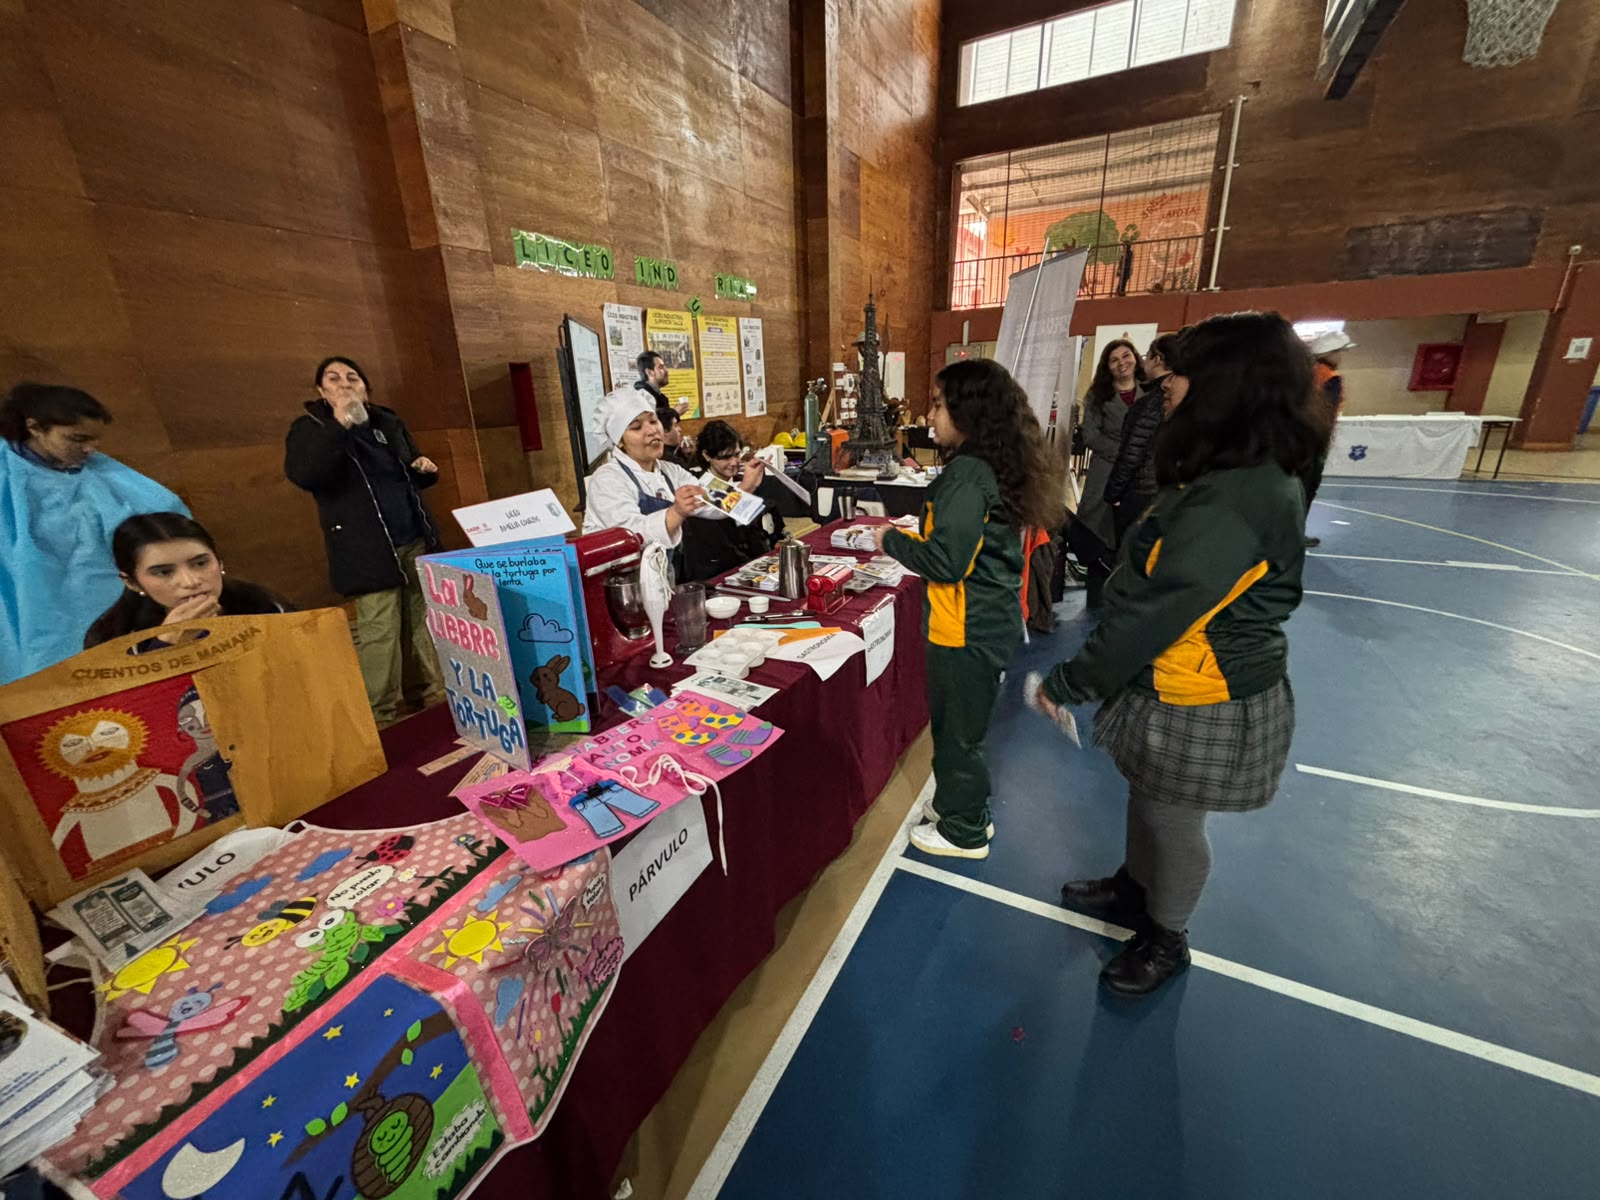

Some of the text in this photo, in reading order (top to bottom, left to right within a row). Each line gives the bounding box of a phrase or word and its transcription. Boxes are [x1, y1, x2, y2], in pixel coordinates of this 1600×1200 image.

[521, 238, 609, 271] LICEO
[640, 262, 675, 283] IND
[475, 558, 494, 569] Que
[508, 556, 547, 567] burlaba
[504, 568, 539, 580] tortuga
[543, 568, 557, 578] por
[425, 564, 459, 607] La
[72, 661, 163, 681] CUENTOS
[168, 654, 193, 670] DE
[450, 658, 499, 703] Y LA
[445, 687, 526, 755] TORTUGA
[590, 734, 642, 763] AUTO
[628, 828, 688, 902] PÁRVULO
[329, 868, 382, 901] No puedo
[348, 879, 380, 900] volar
[432, 1117, 468, 1159] Estaba
